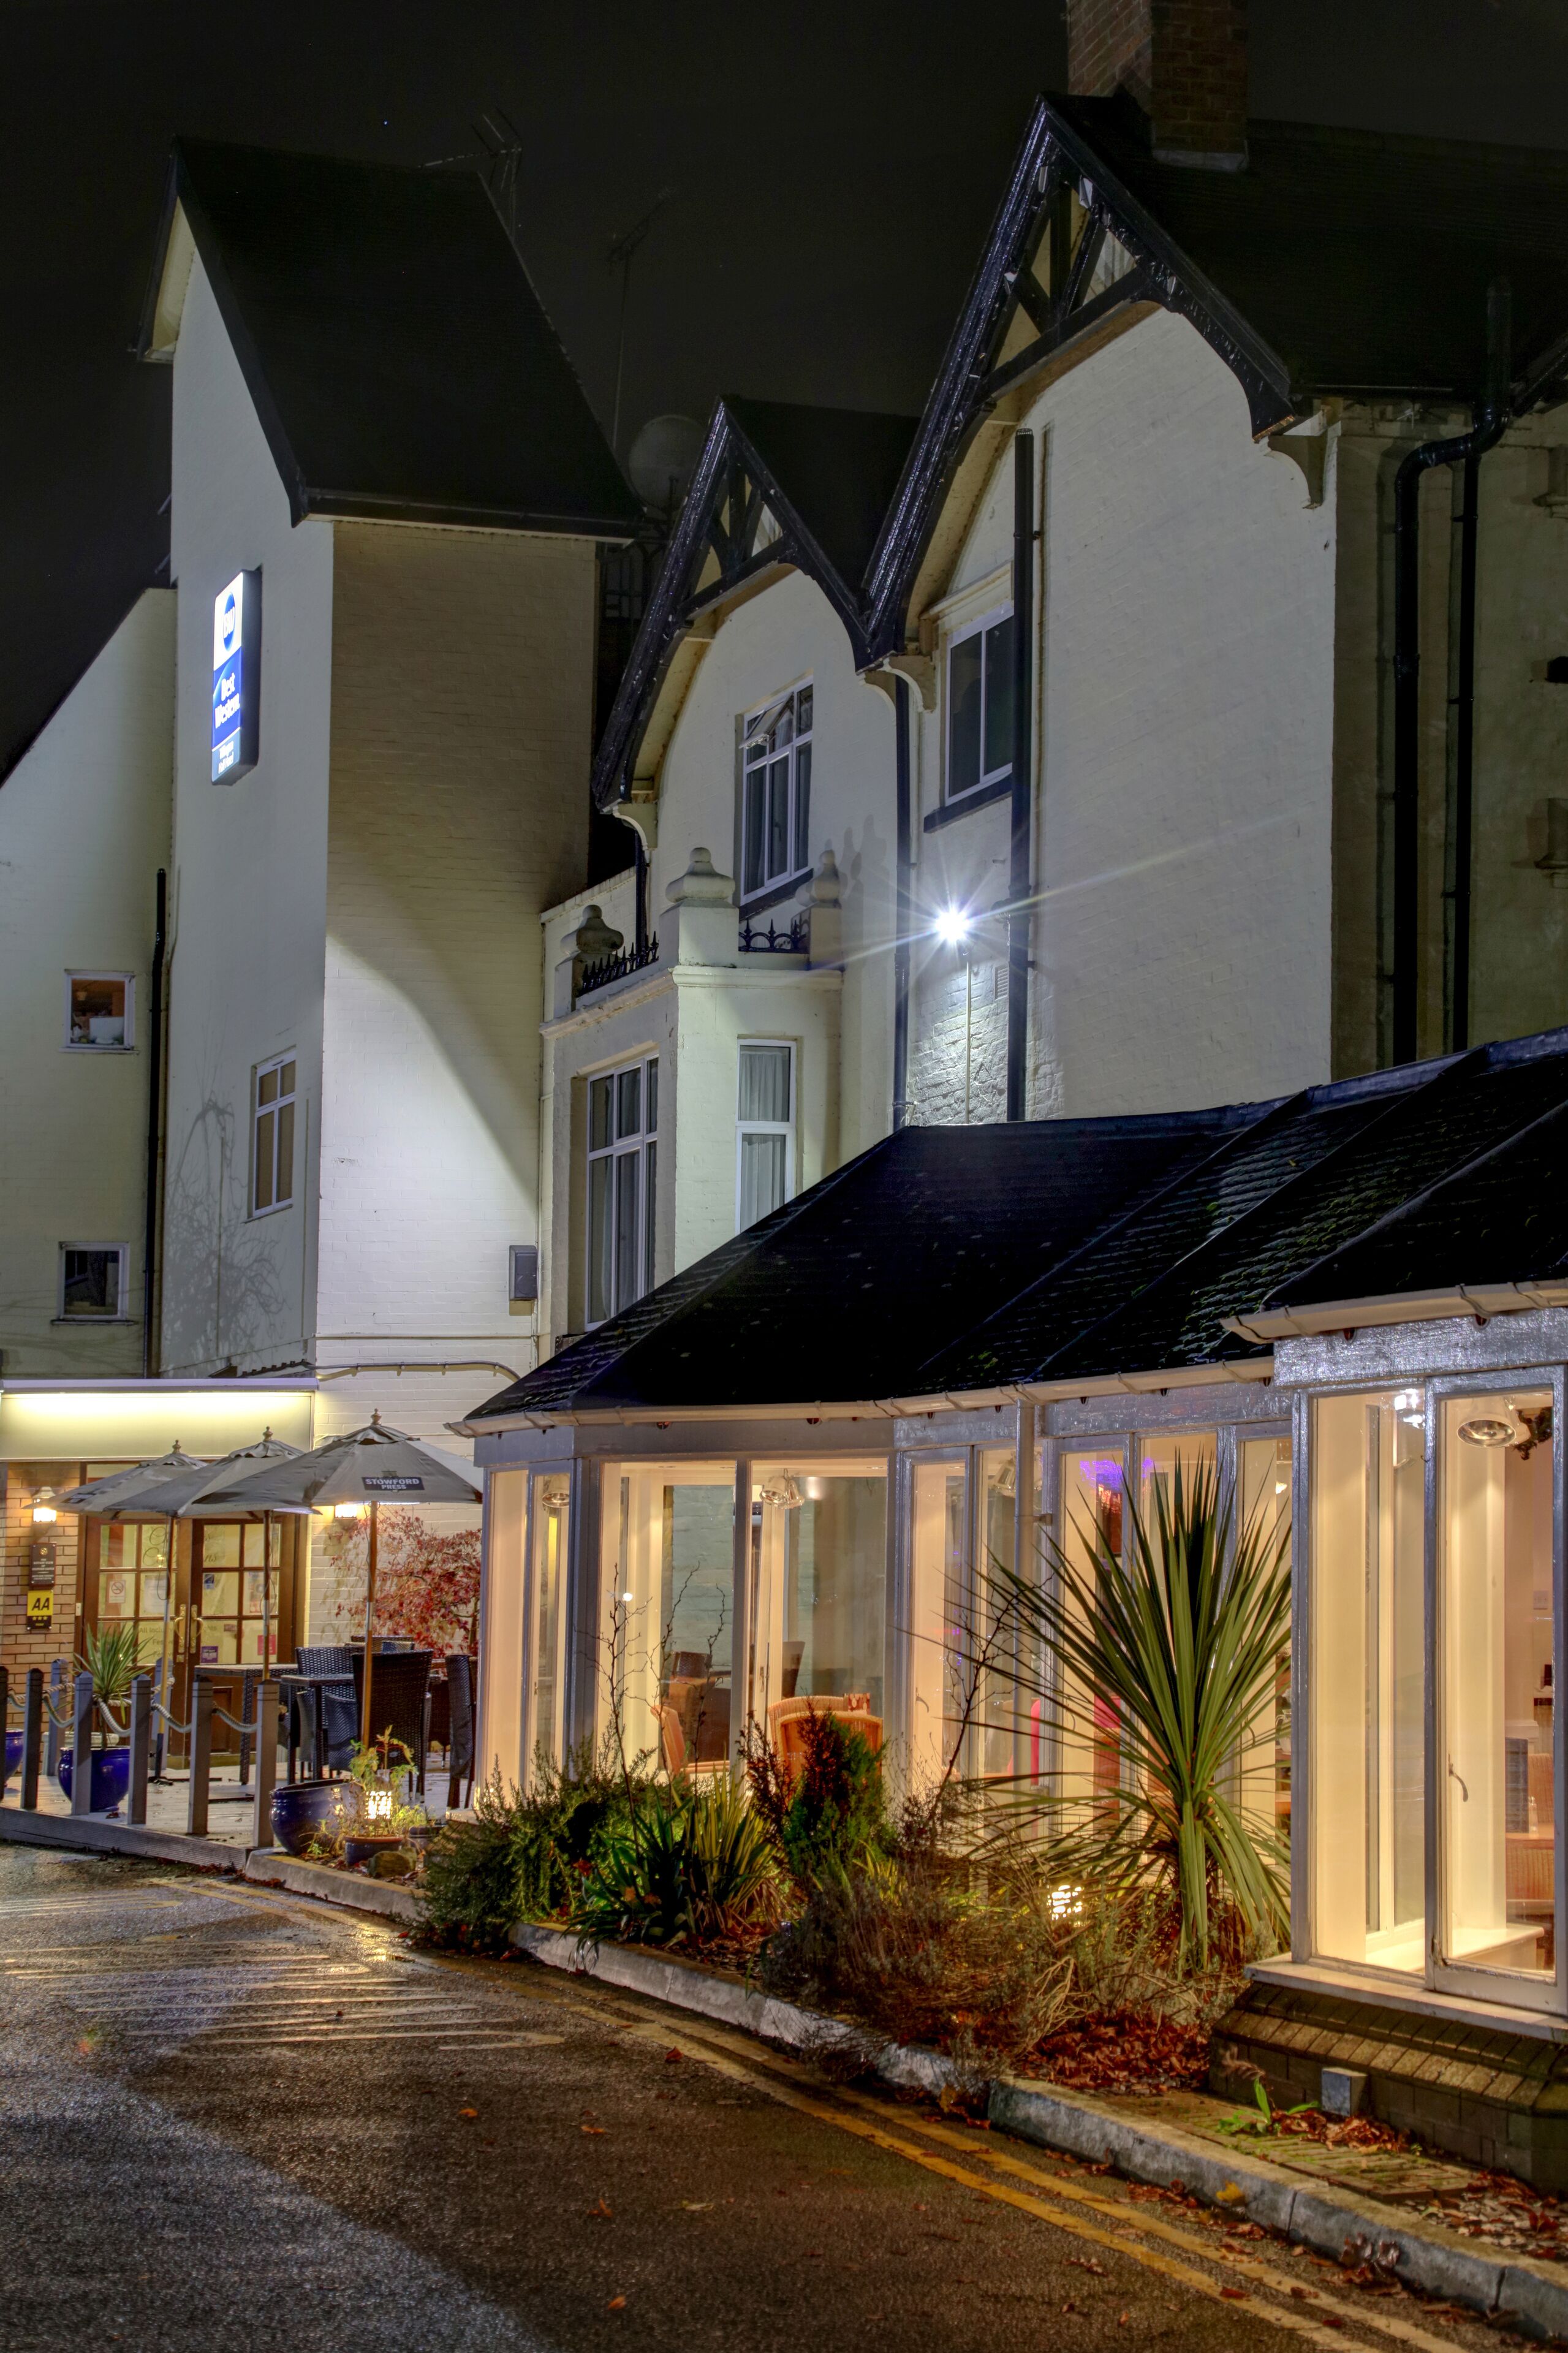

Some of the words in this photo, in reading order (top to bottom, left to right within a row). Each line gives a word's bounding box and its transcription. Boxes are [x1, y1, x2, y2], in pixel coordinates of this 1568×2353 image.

[221, 672, 235, 702] Best
[215, 693, 240, 729] Western
[31, 1597, 50, 1611] AA
